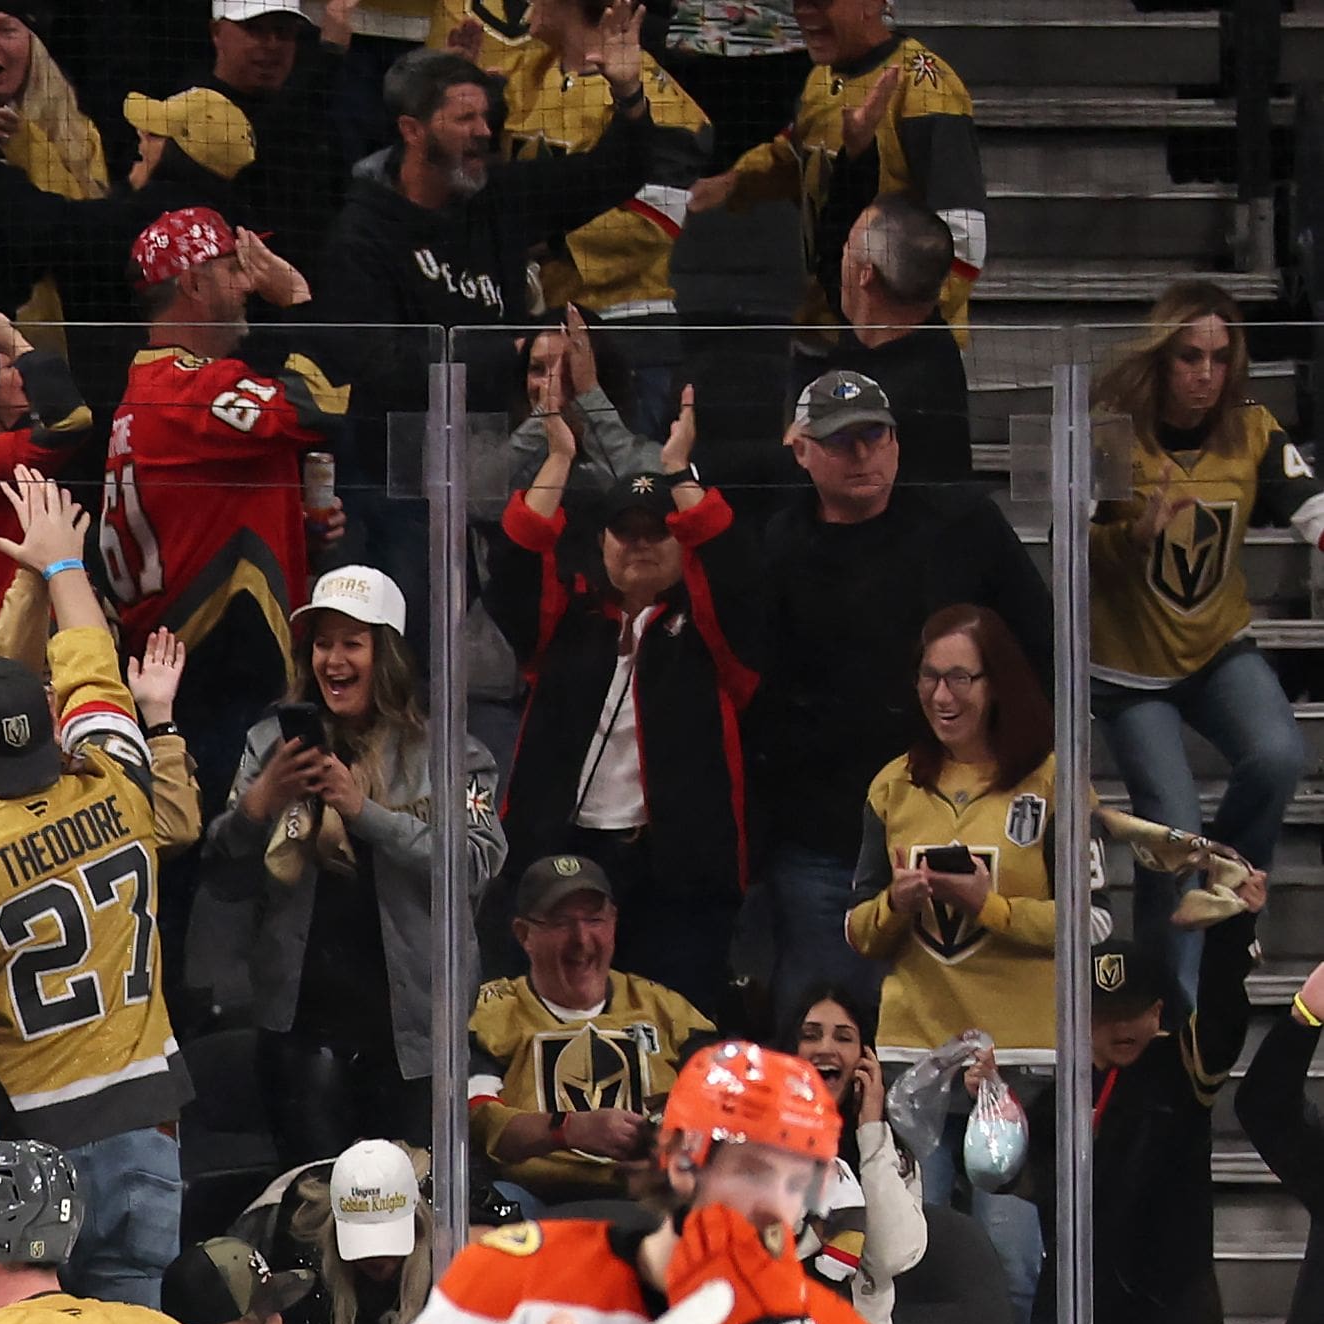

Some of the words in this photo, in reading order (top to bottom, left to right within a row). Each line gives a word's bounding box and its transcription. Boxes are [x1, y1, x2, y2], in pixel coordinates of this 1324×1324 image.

[211, 378, 278, 433] 61
[59, 1198, 72, 1223] 9
[371, 1191, 407, 1214] Knights
